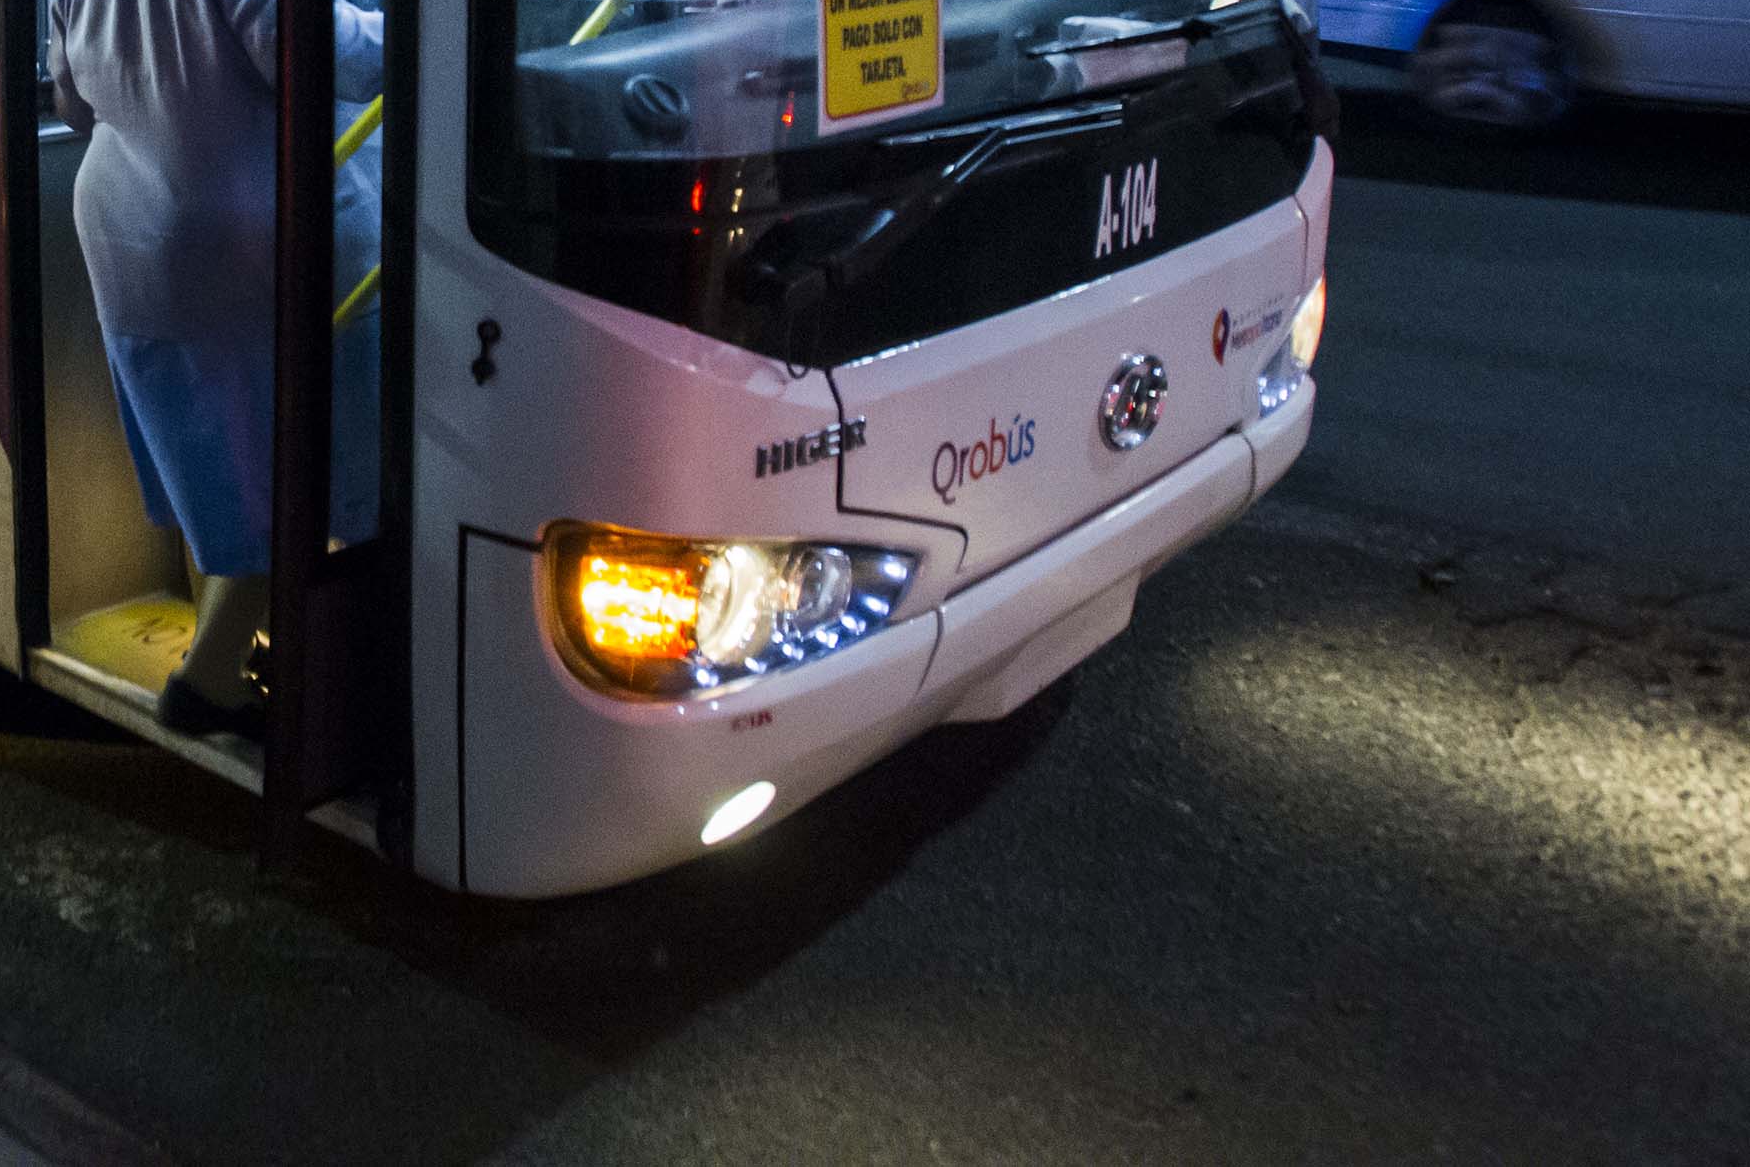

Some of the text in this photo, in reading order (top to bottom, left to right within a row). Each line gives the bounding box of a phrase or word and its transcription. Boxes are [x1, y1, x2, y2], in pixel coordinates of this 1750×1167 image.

[841, 15, 923, 51] PAGO SOLO CON
[1095, 157, 1158, 259] A-104
[755, 414, 867, 479] HIGER
[932, 413, 1036, 505] Qrobús
